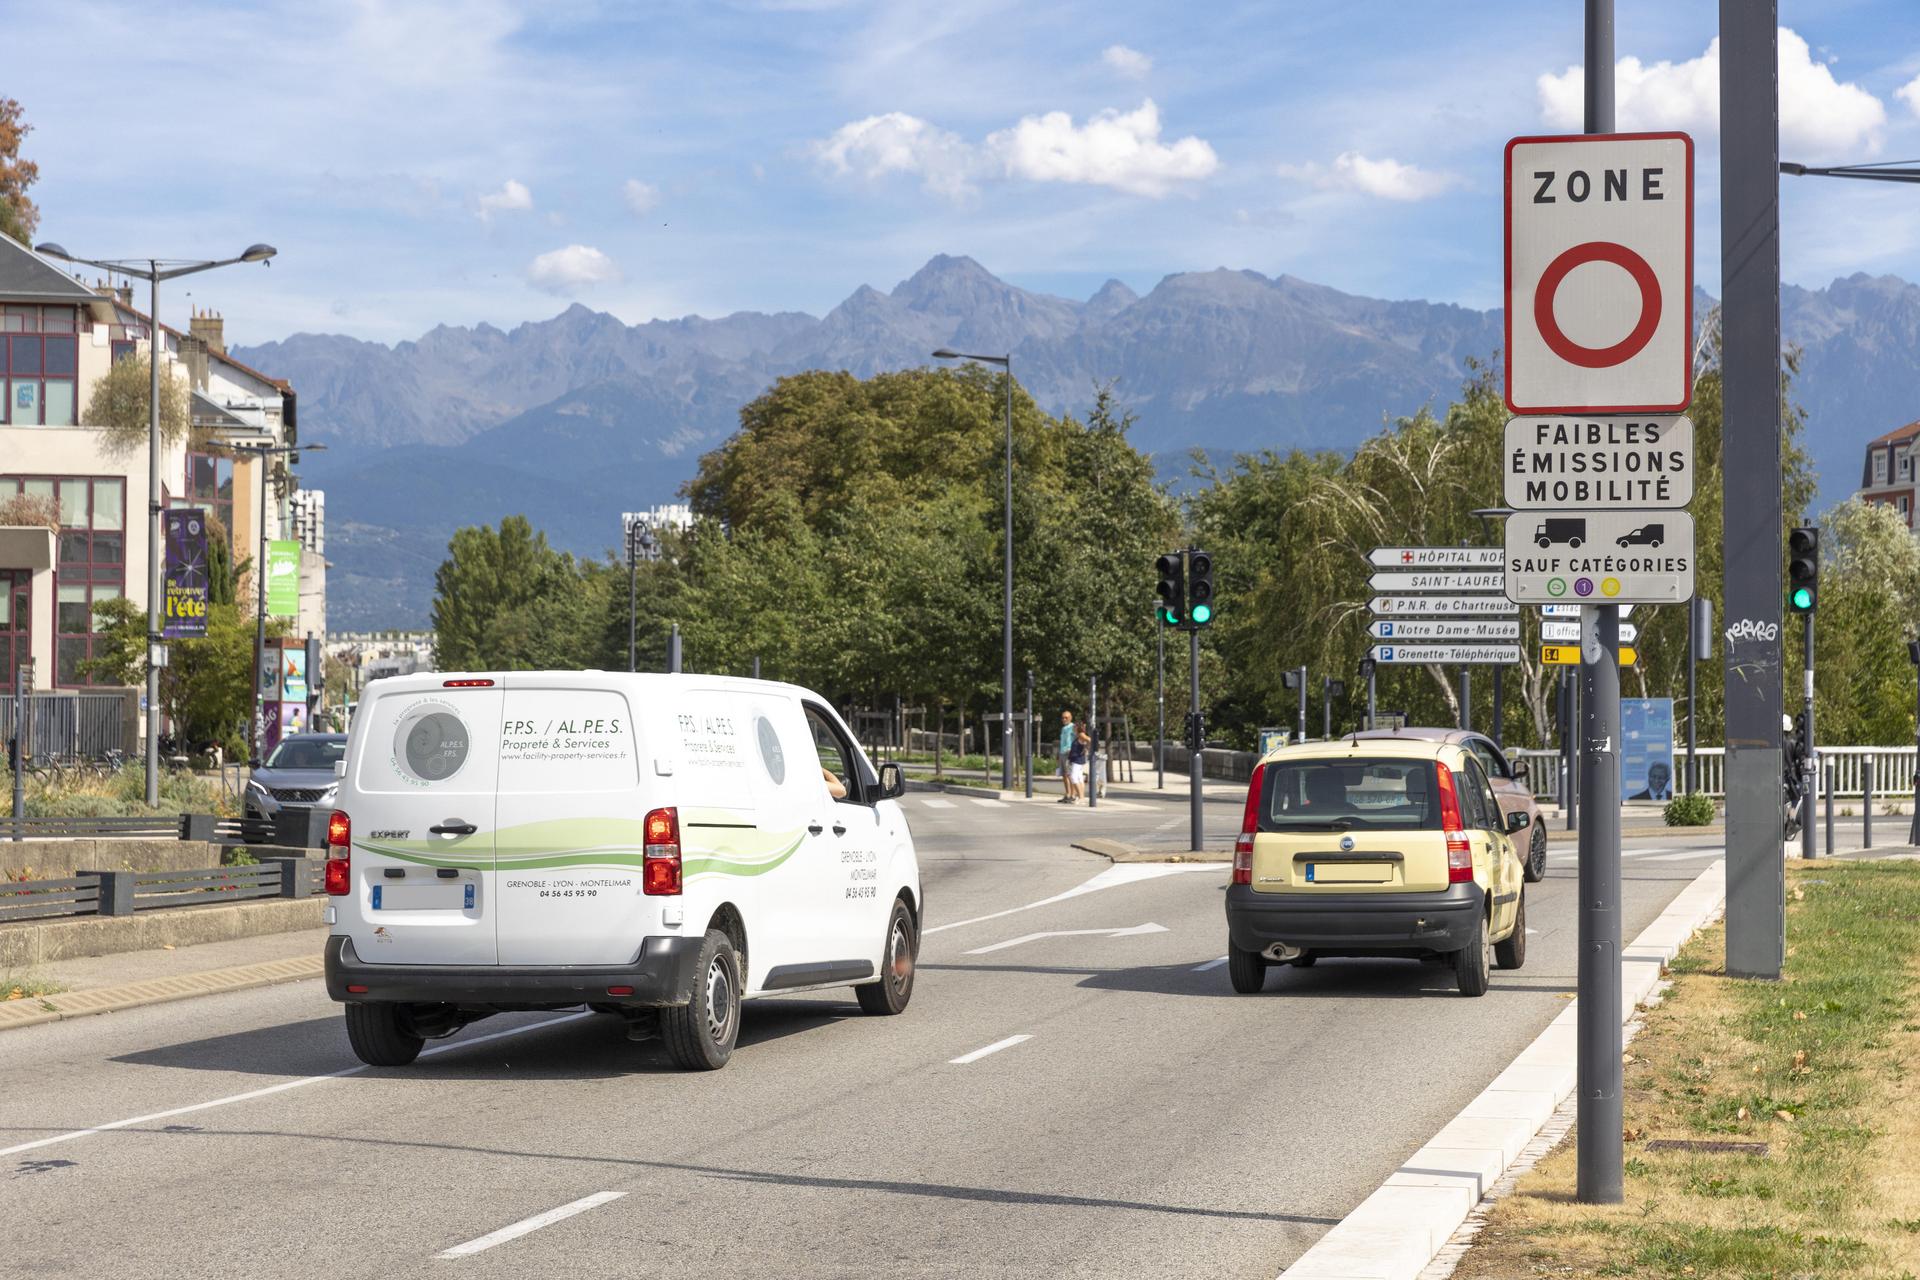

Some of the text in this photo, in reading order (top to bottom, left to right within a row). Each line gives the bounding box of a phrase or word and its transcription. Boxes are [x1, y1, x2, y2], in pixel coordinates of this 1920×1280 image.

[1533, 168, 1664, 204] ZONE
[1536, 423, 1660, 445] FAIBLES
[1512, 449, 1685, 473] ÉMISSIONS
[1526, 475, 1670, 501] MOBILITÉ
[1418, 550, 1472, 562] HÔPITAL
[1512, 556, 1687, 572] SAUF CATÉGORIES
[1397, 600, 1516, 611] P.N.R. de Chartreuse
[1397, 625, 1431, 635] Notre
[1436, 624, 1516, 635] Dame-Musée
[1398, 648, 1516, 661] Grenette-Téléphérique
[503, 720, 537, 735] F.P.S.
[557, 719, 623, 734] AL.P.E.S.
[502, 738, 610, 751] Propreté & Services
[501, 751, 627, 761] www.facility-property-services.fr
[370, 830, 411, 839] EXPERT
[506, 880, 546, 888] GRENOBLE
[553, 880, 574, 888] LYON
[580, 879, 632, 887] MONTELIMAR
[587, 889, 597, 897] 90
